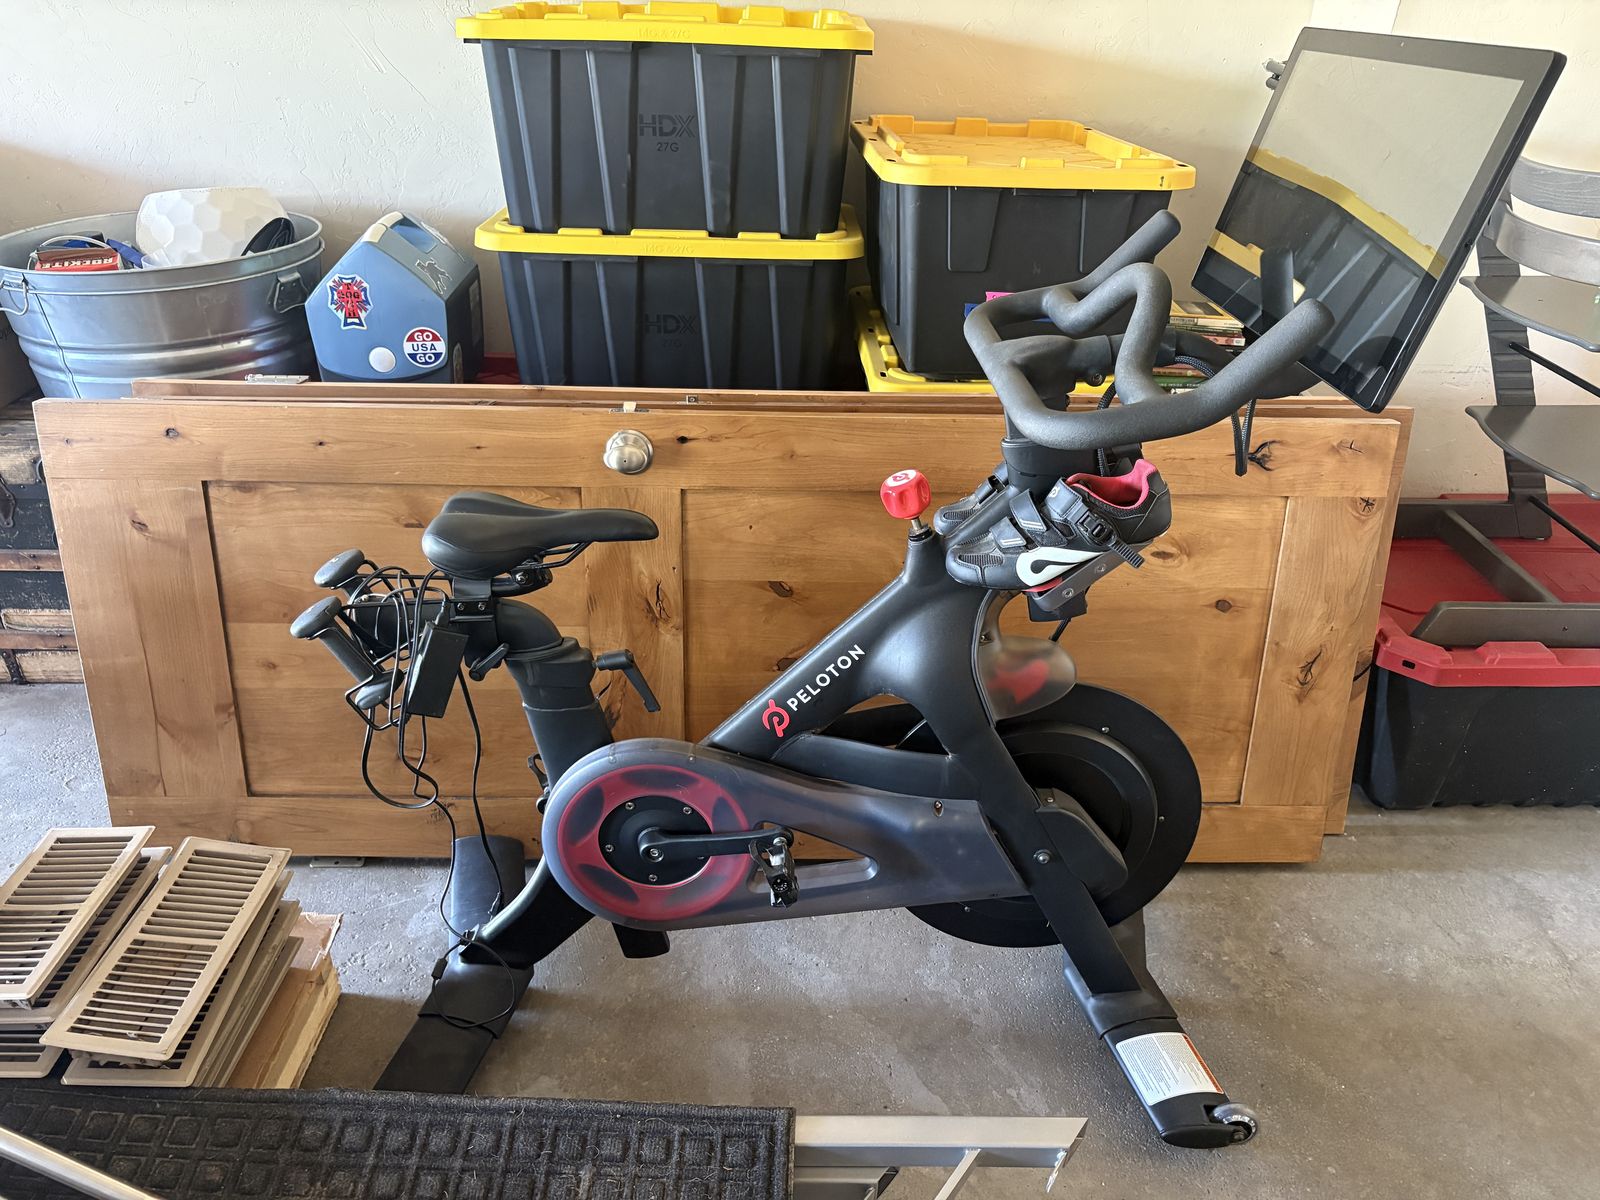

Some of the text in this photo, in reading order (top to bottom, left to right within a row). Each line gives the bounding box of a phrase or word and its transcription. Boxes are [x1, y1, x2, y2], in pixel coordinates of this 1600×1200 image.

[639, 113, 696, 138] HDX
[656, 142, 680, 152] 27G
[41, 257, 113, 269] ROCKITE
[644, 313, 697, 337] HDX
[414, 331, 433, 342] GO
[411, 343, 437, 352] USA
[416, 353, 435, 363] GO
[786, 644, 866, 711] PELOTON
